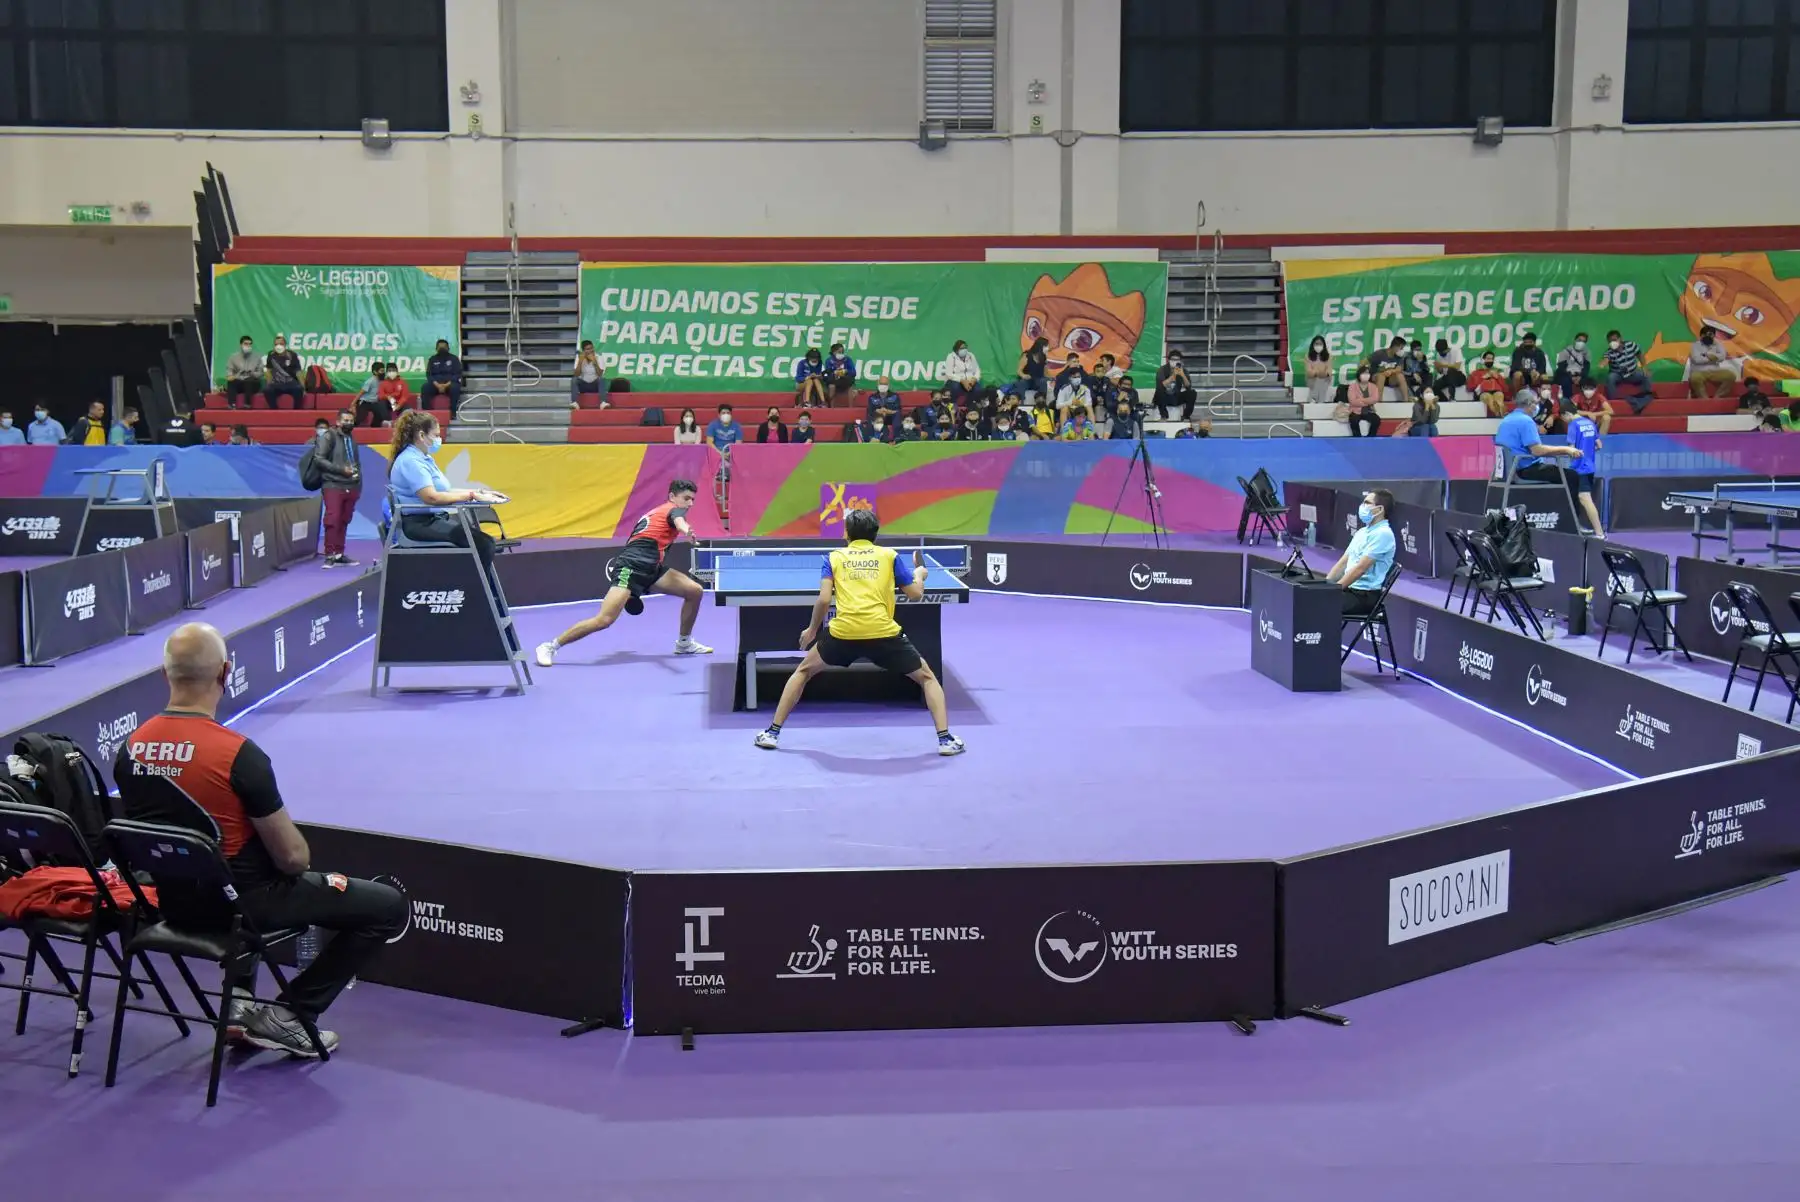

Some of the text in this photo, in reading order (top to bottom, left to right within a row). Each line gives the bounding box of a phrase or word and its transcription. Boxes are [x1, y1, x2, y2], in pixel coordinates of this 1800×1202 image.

[471, 114, 480, 125] S
[1032, 115, 1041, 126] S
[600, 287, 920, 320] CUIDAMOS ESTA SEDE
[1322, 283, 1637, 323] ESTA SEDE LEGADO
[372, 332, 399, 351] ES
[600, 318, 870, 353] PARA QUE ESTÉ EN
[1326, 329, 1365, 356] ES
[600, 352, 764, 379] PERFECTAS
[843, 559, 880, 569] ECUADOR
[428, 604, 463, 614] DHS
[1635, 710, 1651, 726] TABLE
[1633, 721, 1644, 734] FOR
[1632, 731, 1643, 744] FOR
[129, 741, 195, 762] PERÚ
[132, 762, 183, 776] R. Baster
[1707, 798, 1767, 822] TABLE TENNIS.
[1706, 818, 1743, 836] FOR ALL.
[1705, 830, 1745, 850] FOR LIFE.
[1400, 861, 1500, 931] SOCOSANI
[412, 900, 445, 918] WTT
[412, 914, 504, 943] YOUTH SERIES
[846, 926, 985, 943] TABLE TENNIS.
[1110, 930, 1156, 946] WTT
[847, 944, 928, 959] FOR ALL.
[1110, 943, 1238, 961] YOUTH SERIES
[847, 960, 936, 976] FOR LIFE.
[675, 975, 725, 987] TEOMA
[709, 987, 726, 995] bien
